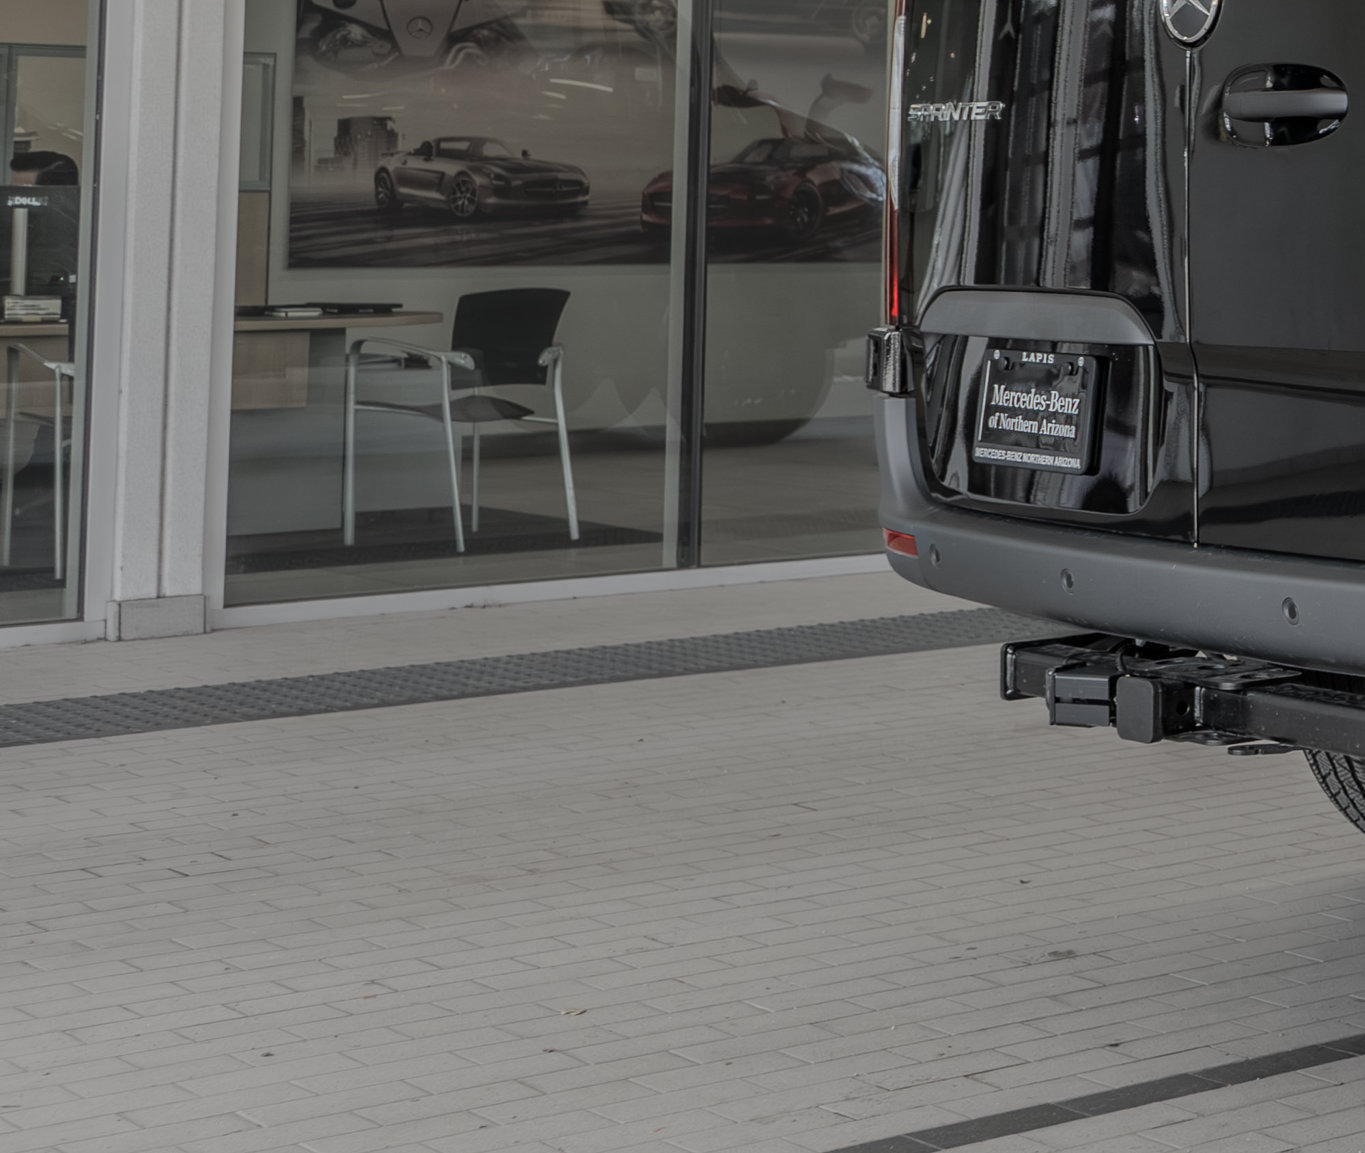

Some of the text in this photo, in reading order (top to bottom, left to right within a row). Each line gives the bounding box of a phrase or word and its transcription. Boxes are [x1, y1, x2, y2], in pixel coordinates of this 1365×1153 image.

[907, 101, 1004, 121] SPRINTER
[1022, 352, 1055, 364] LAPIS
[991, 384, 1080, 414] Mercedes-Benz
[988, 413, 1075, 438] of Northern Arizona
[975, 447, 1081, 469] MERCEDES-BENZ NORTHERN ARIZONA
